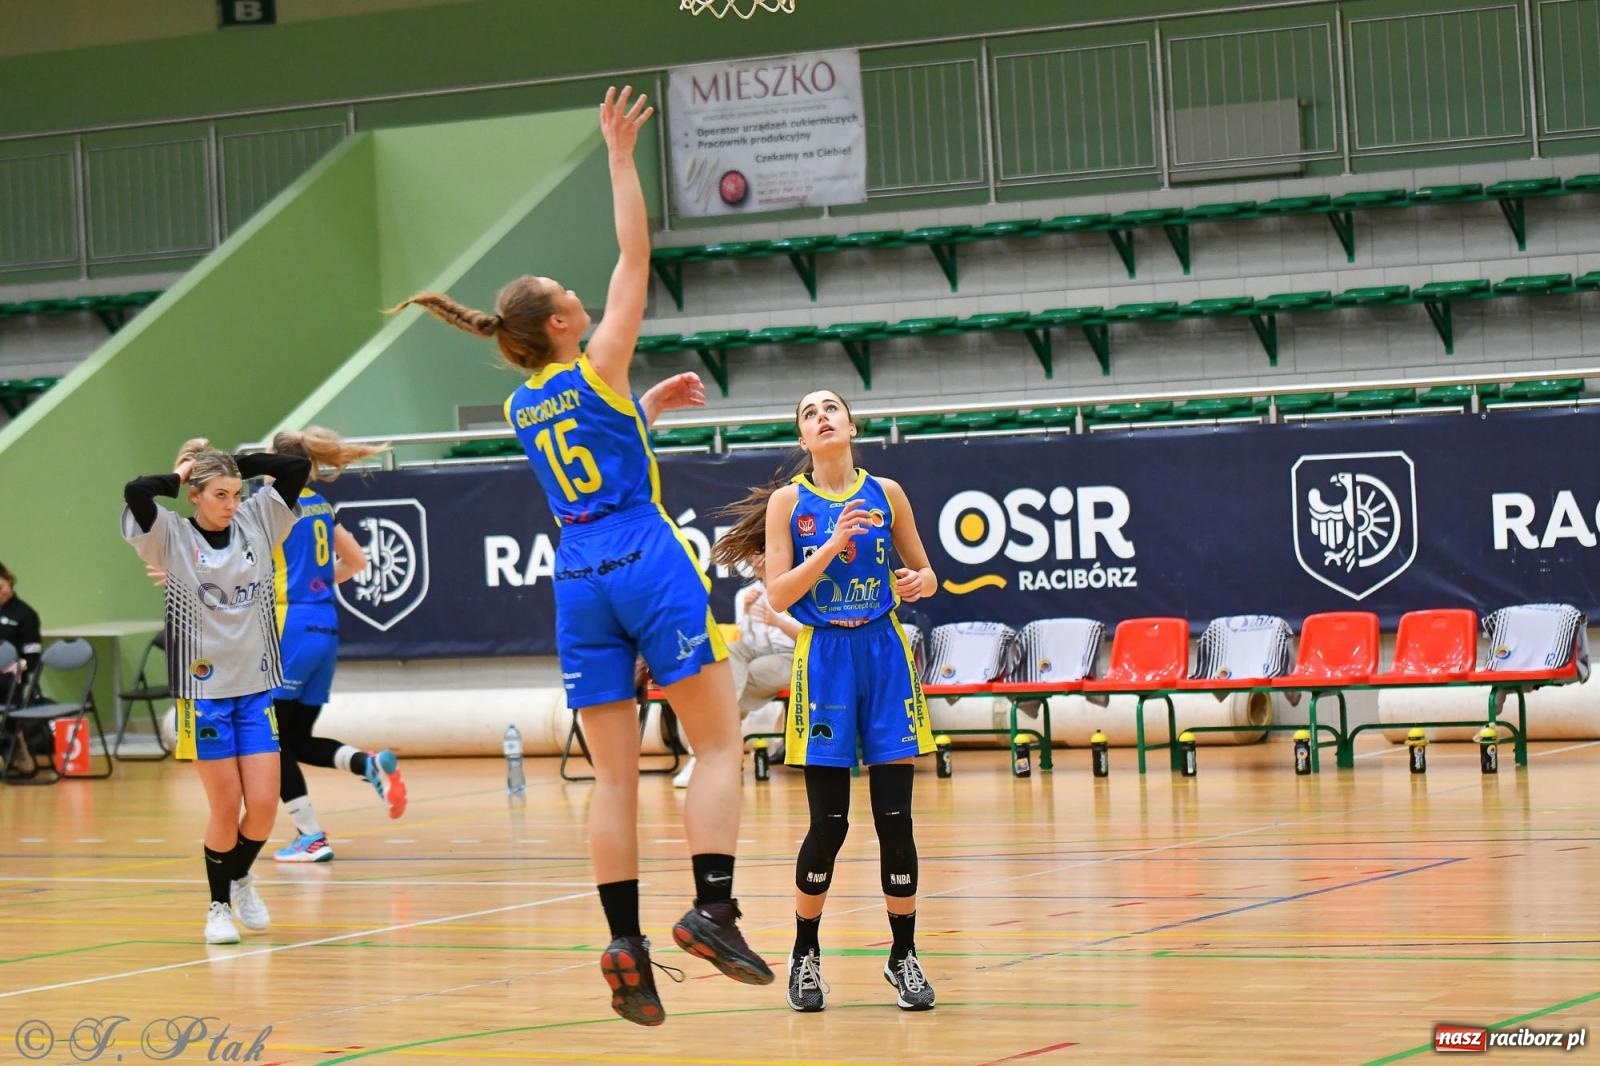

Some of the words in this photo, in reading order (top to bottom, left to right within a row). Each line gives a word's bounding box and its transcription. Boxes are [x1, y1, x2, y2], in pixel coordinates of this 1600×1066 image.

[235, 0, 263, 21] B
[692, 61, 836, 104] MIESZKO
[697, 126, 740, 137] Operator
[790, 113, 859, 128] cukierniczych
[697, 138, 748, 149] Pracownik
[750, 131, 811, 145] produkcyjny
[755, 152, 799, 164] Czekamy
[802, 151, 814, 159] na
[534, 418, 603, 502] 15
[1491, 490, 1600, 550] RA
[313, 519, 330, 567] 8
[876, 538, 885, 564] 5
[597, 550, 643, 576] decor
[1018, 562, 1138, 591] RACIBÓRZ
[795, 658, 805, 739] CHROBRY
[813, 872, 827, 883] NBA
[896, 874, 911, 885] NBA
